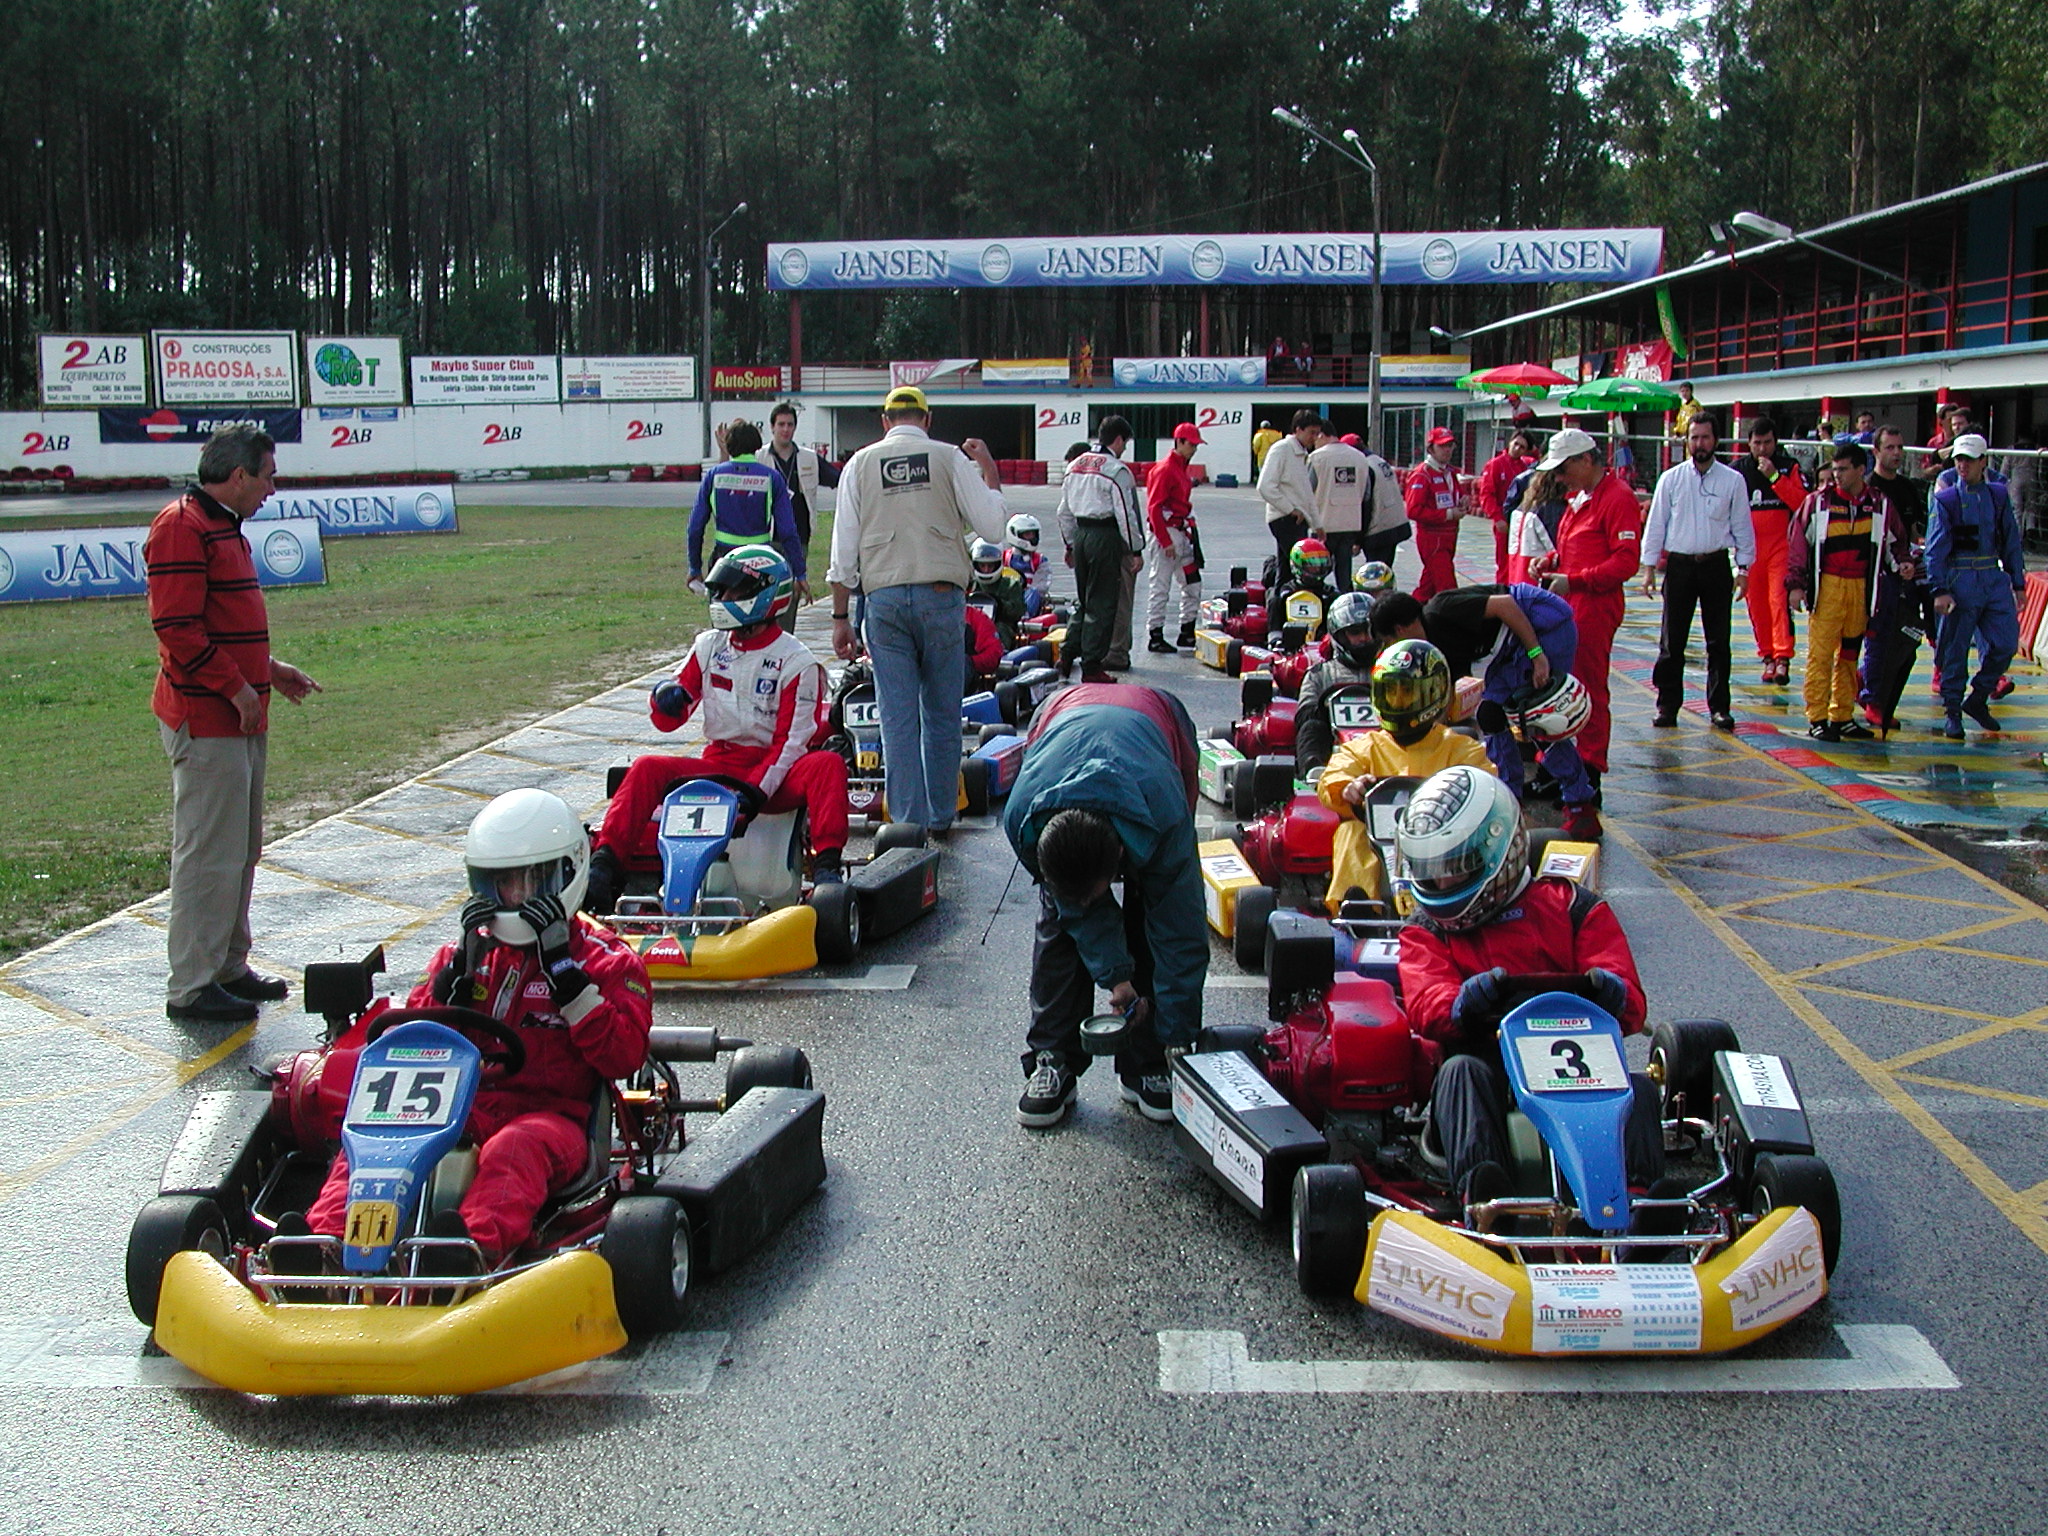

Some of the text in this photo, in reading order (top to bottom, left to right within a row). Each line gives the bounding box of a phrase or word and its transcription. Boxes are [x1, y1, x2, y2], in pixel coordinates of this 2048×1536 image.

[834, 250, 947, 277] JANSEN
[1040, 246, 1162, 274] JANSEN
[1254, 244, 1388, 273] JANSEN
[1490, 240, 1631, 271] JANSEN
[61, 340, 127, 370] 2AB
[192, 343, 272, 355] CONSTRUÇÕES
[61, 371, 127, 383] EQUIPAMENTOS
[166, 360, 287, 379] PRAGOSA, S.A.
[431, 360, 469, 373] Maybe
[509, 360, 534, 370] Club
[1150, 363, 1229, 382] JANSEN
[443, 384, 460, 392] Leiria
[713, 369, 778, 391] AutoSport
[1038, 408, 1081, 429] 2AB
[1199, 407, 1243, 428] 2AB
[330, 425, 372, 448] 2AB
[483, 424, 522, 445] 2AB
[627, 420, 663, 441] 2AB
[22, 431, 70, 456] 2AB
[275, 495, 396, 526] JANSEN
[1298, 604, 1309, 616] 5
[851, 704, 880, 721] 10
[1338, 705, 1374, 722] 12
[687, 807, 704, 829] 1
[651, 947, 680, 956] Delta
[391, 1049, 449, 1057] EUROINDY
[1550, 1039, 1591, 1079] 3
[366, 1071, 446, 1119] 15
[1471, 1326, 1489, 1338] Lda
